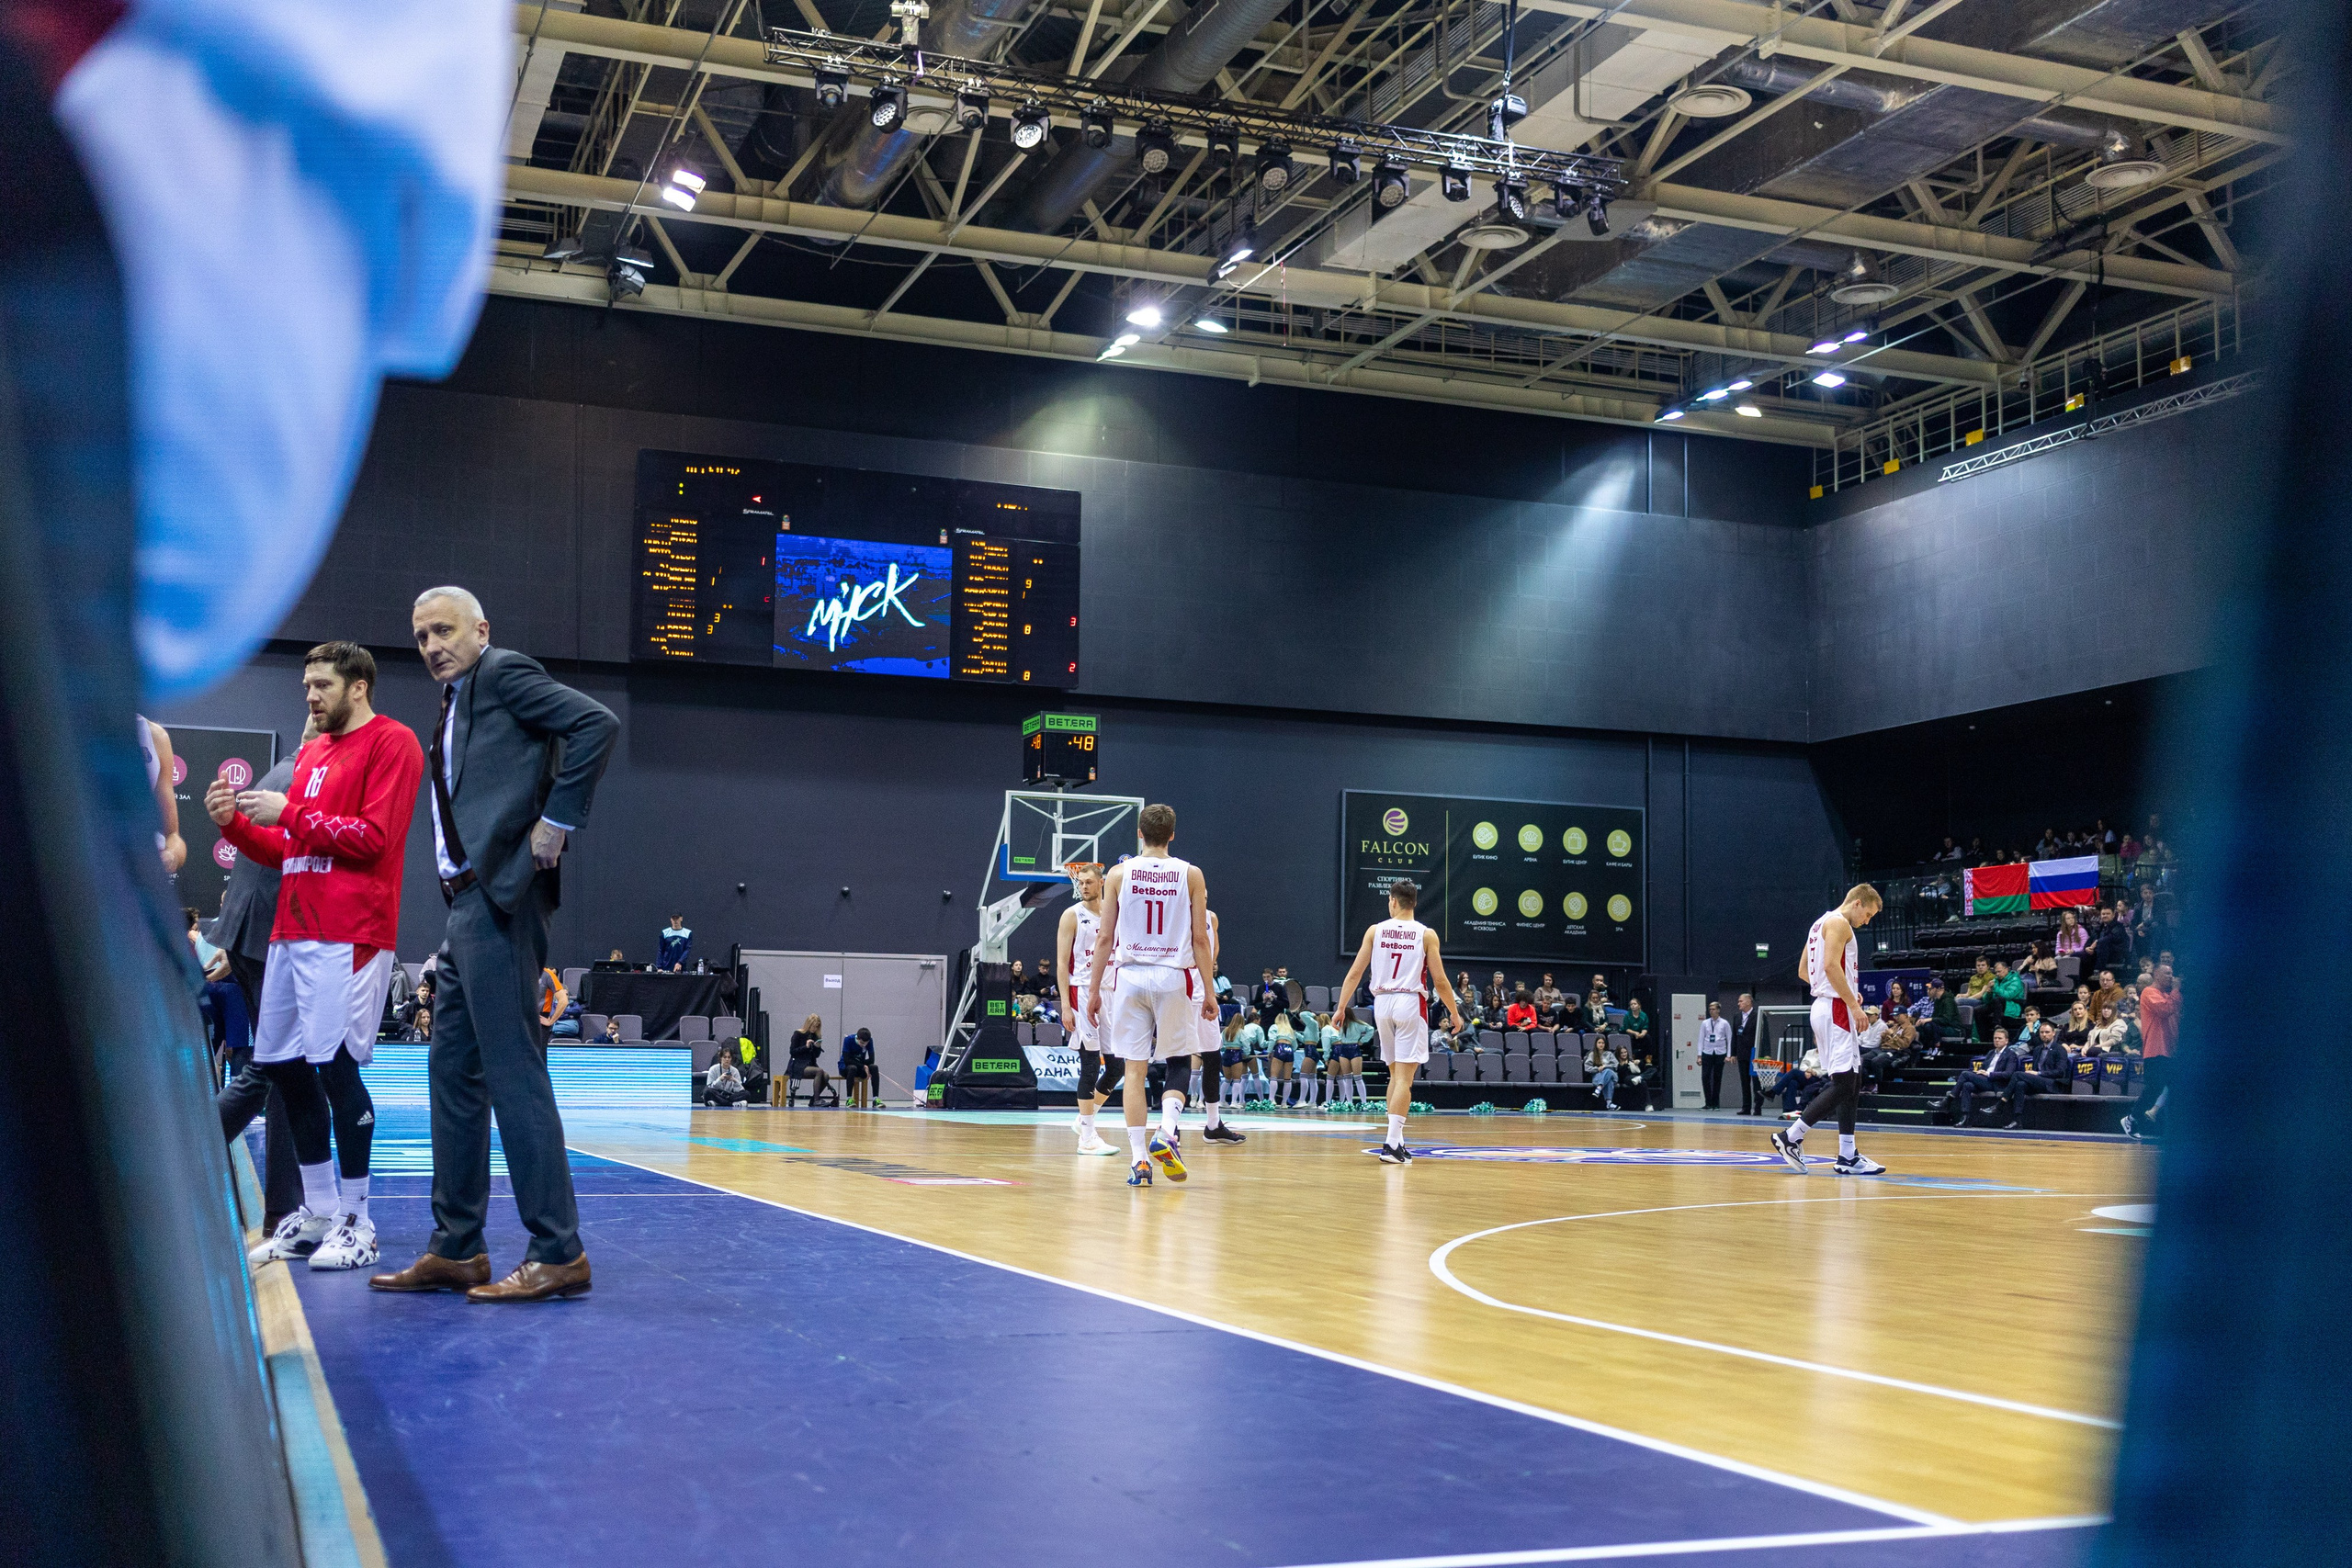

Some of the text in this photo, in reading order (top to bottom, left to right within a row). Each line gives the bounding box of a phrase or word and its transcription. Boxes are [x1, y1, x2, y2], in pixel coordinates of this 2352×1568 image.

[1048, 717, 1093, 728] BETERA
[1361, 840, 1430, 856] FALCON
[1131, 869, 1180, 883] BARASHKOV
[1132, 886, 1177, 897] BetBoom
[1145, 900, 1164, 935] 11
[1382, 930, 1417, 941] KHOMENKO
[1380, 942, 1415, 951] BetBoom
[1391, 953, 1403, 979] 7
[975, 1061, 1018, 1070] BETERA
[2077, 1063, 2094, 1074] VIP
[2106, 1063, 2123, 1074] VIP
